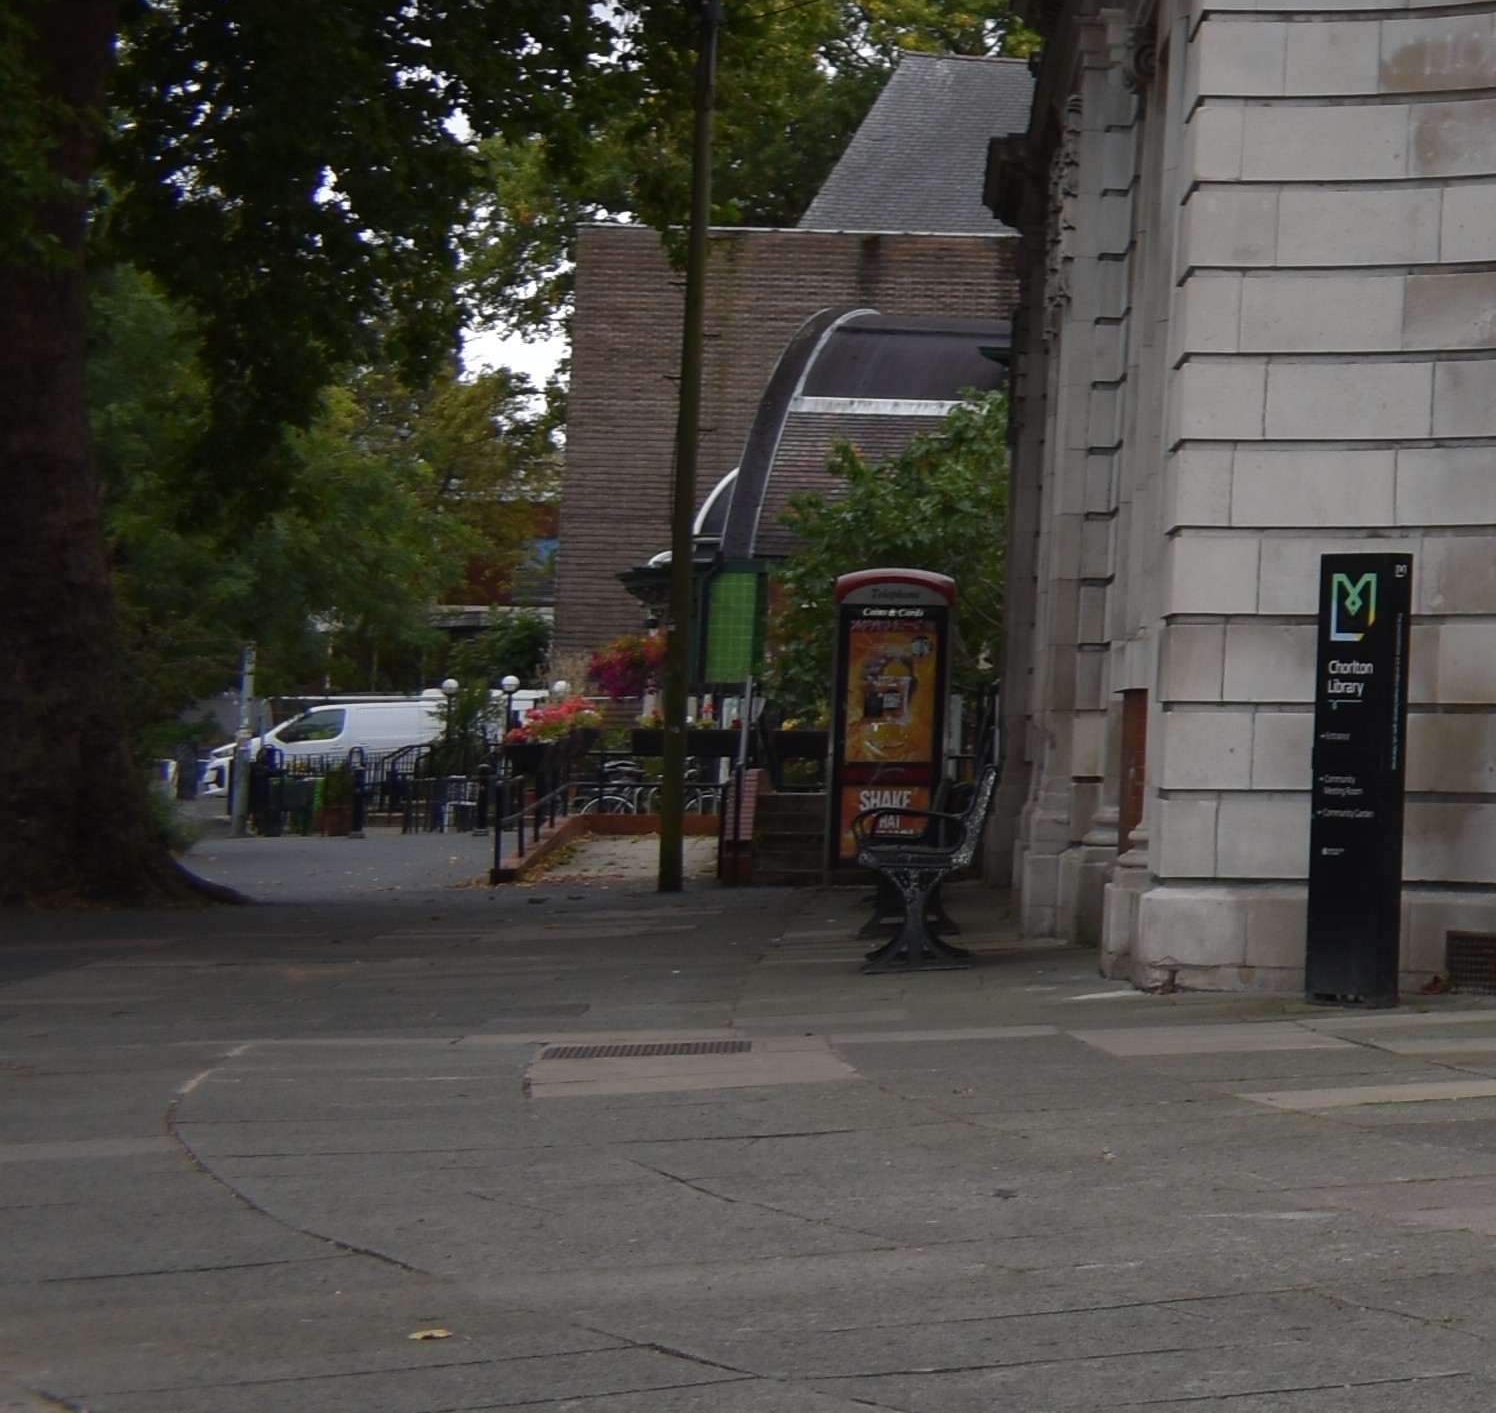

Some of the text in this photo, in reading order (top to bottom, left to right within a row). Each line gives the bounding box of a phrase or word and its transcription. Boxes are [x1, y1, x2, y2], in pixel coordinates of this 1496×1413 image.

[1327, 659, 1374, 675] Chorlton
[1326, 678, 1365, 697] Library
[859, 789, 912, 811] SHAKE
